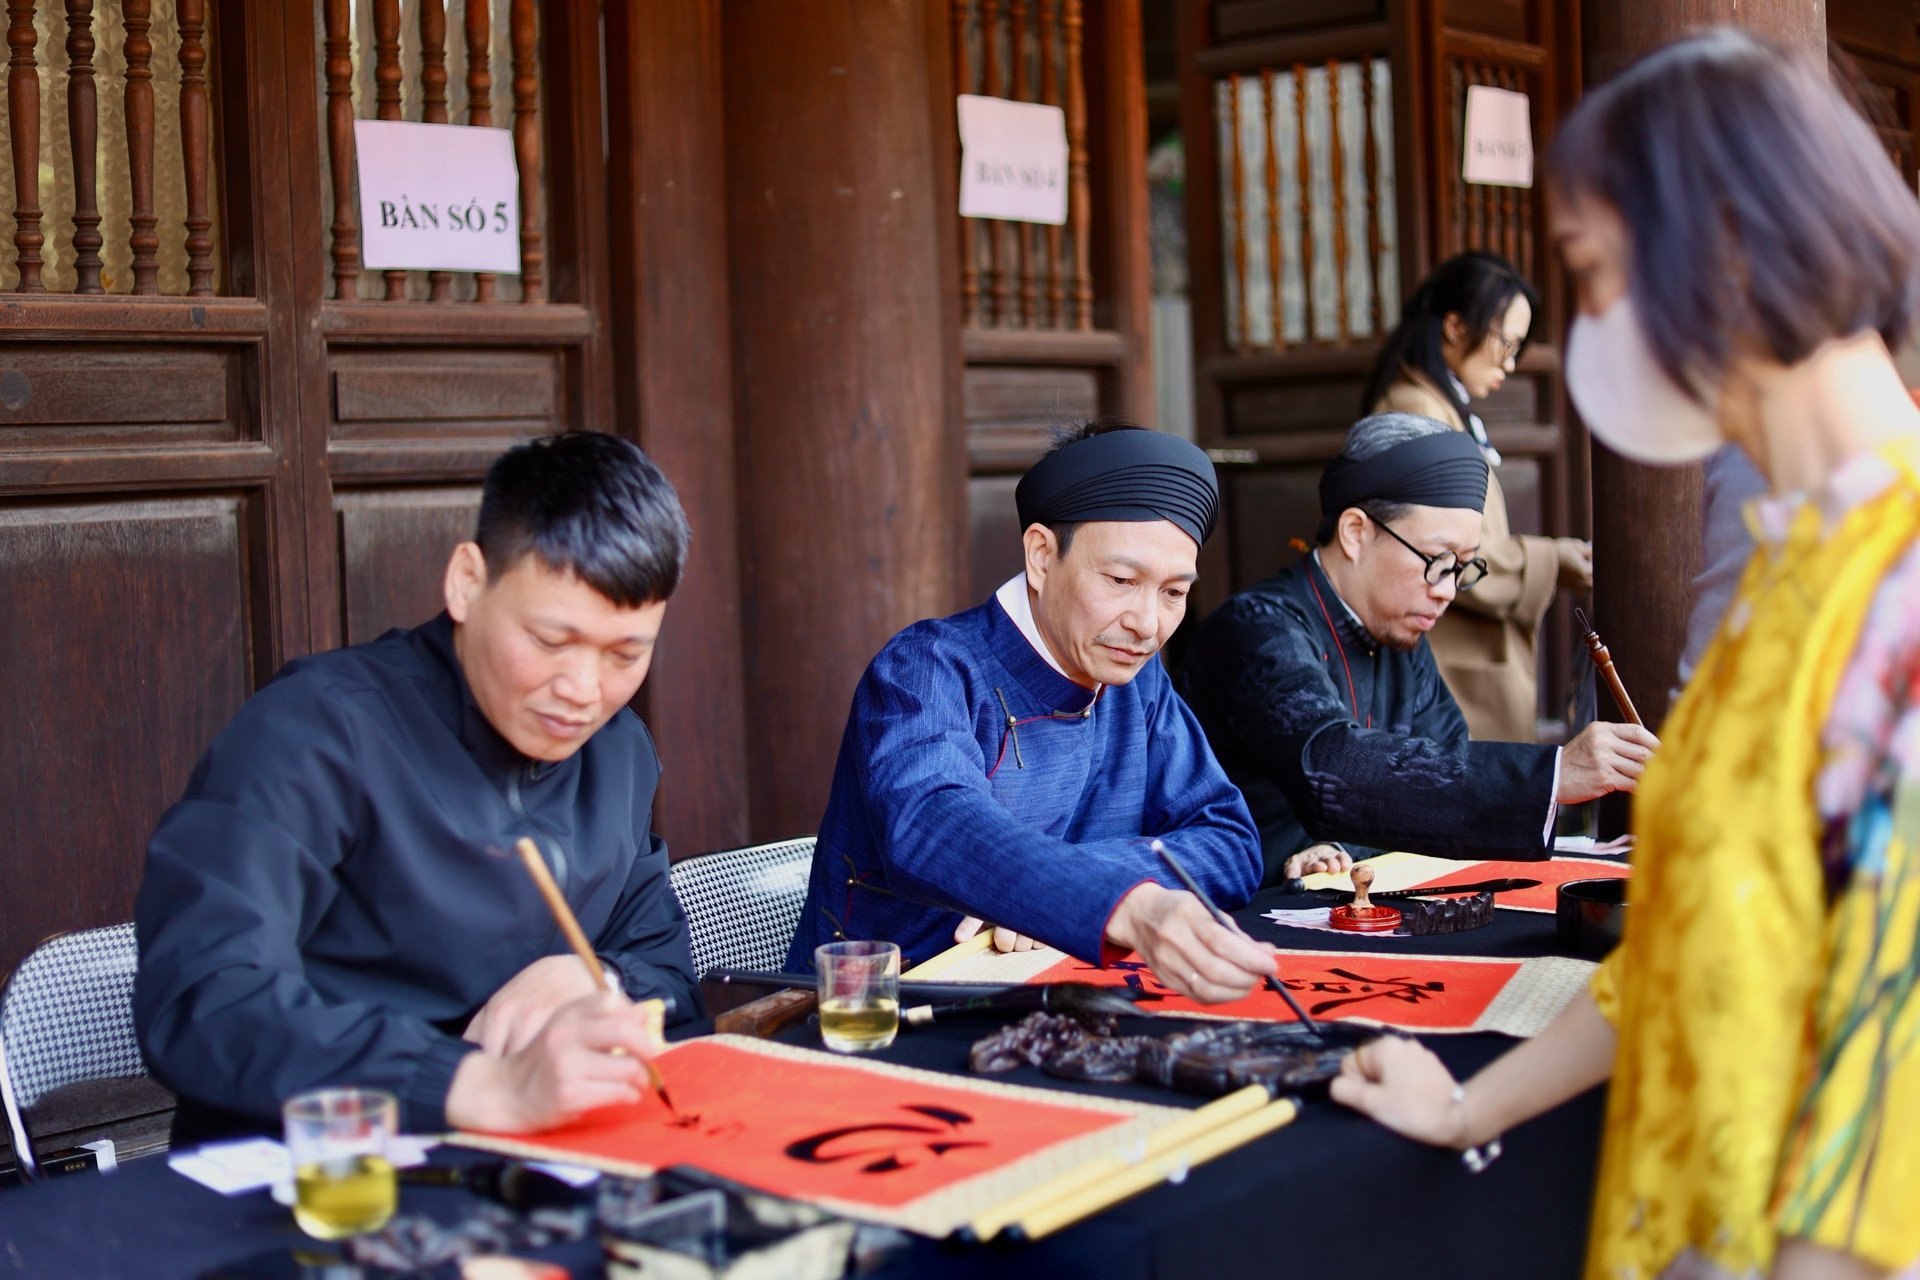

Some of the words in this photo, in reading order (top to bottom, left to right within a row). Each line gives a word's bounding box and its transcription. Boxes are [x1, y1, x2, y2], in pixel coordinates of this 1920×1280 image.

[378, 194, 440, 230] BÀN
[447, 197, 486, 233] SỐ
[494, 202, 508, 233] 5
